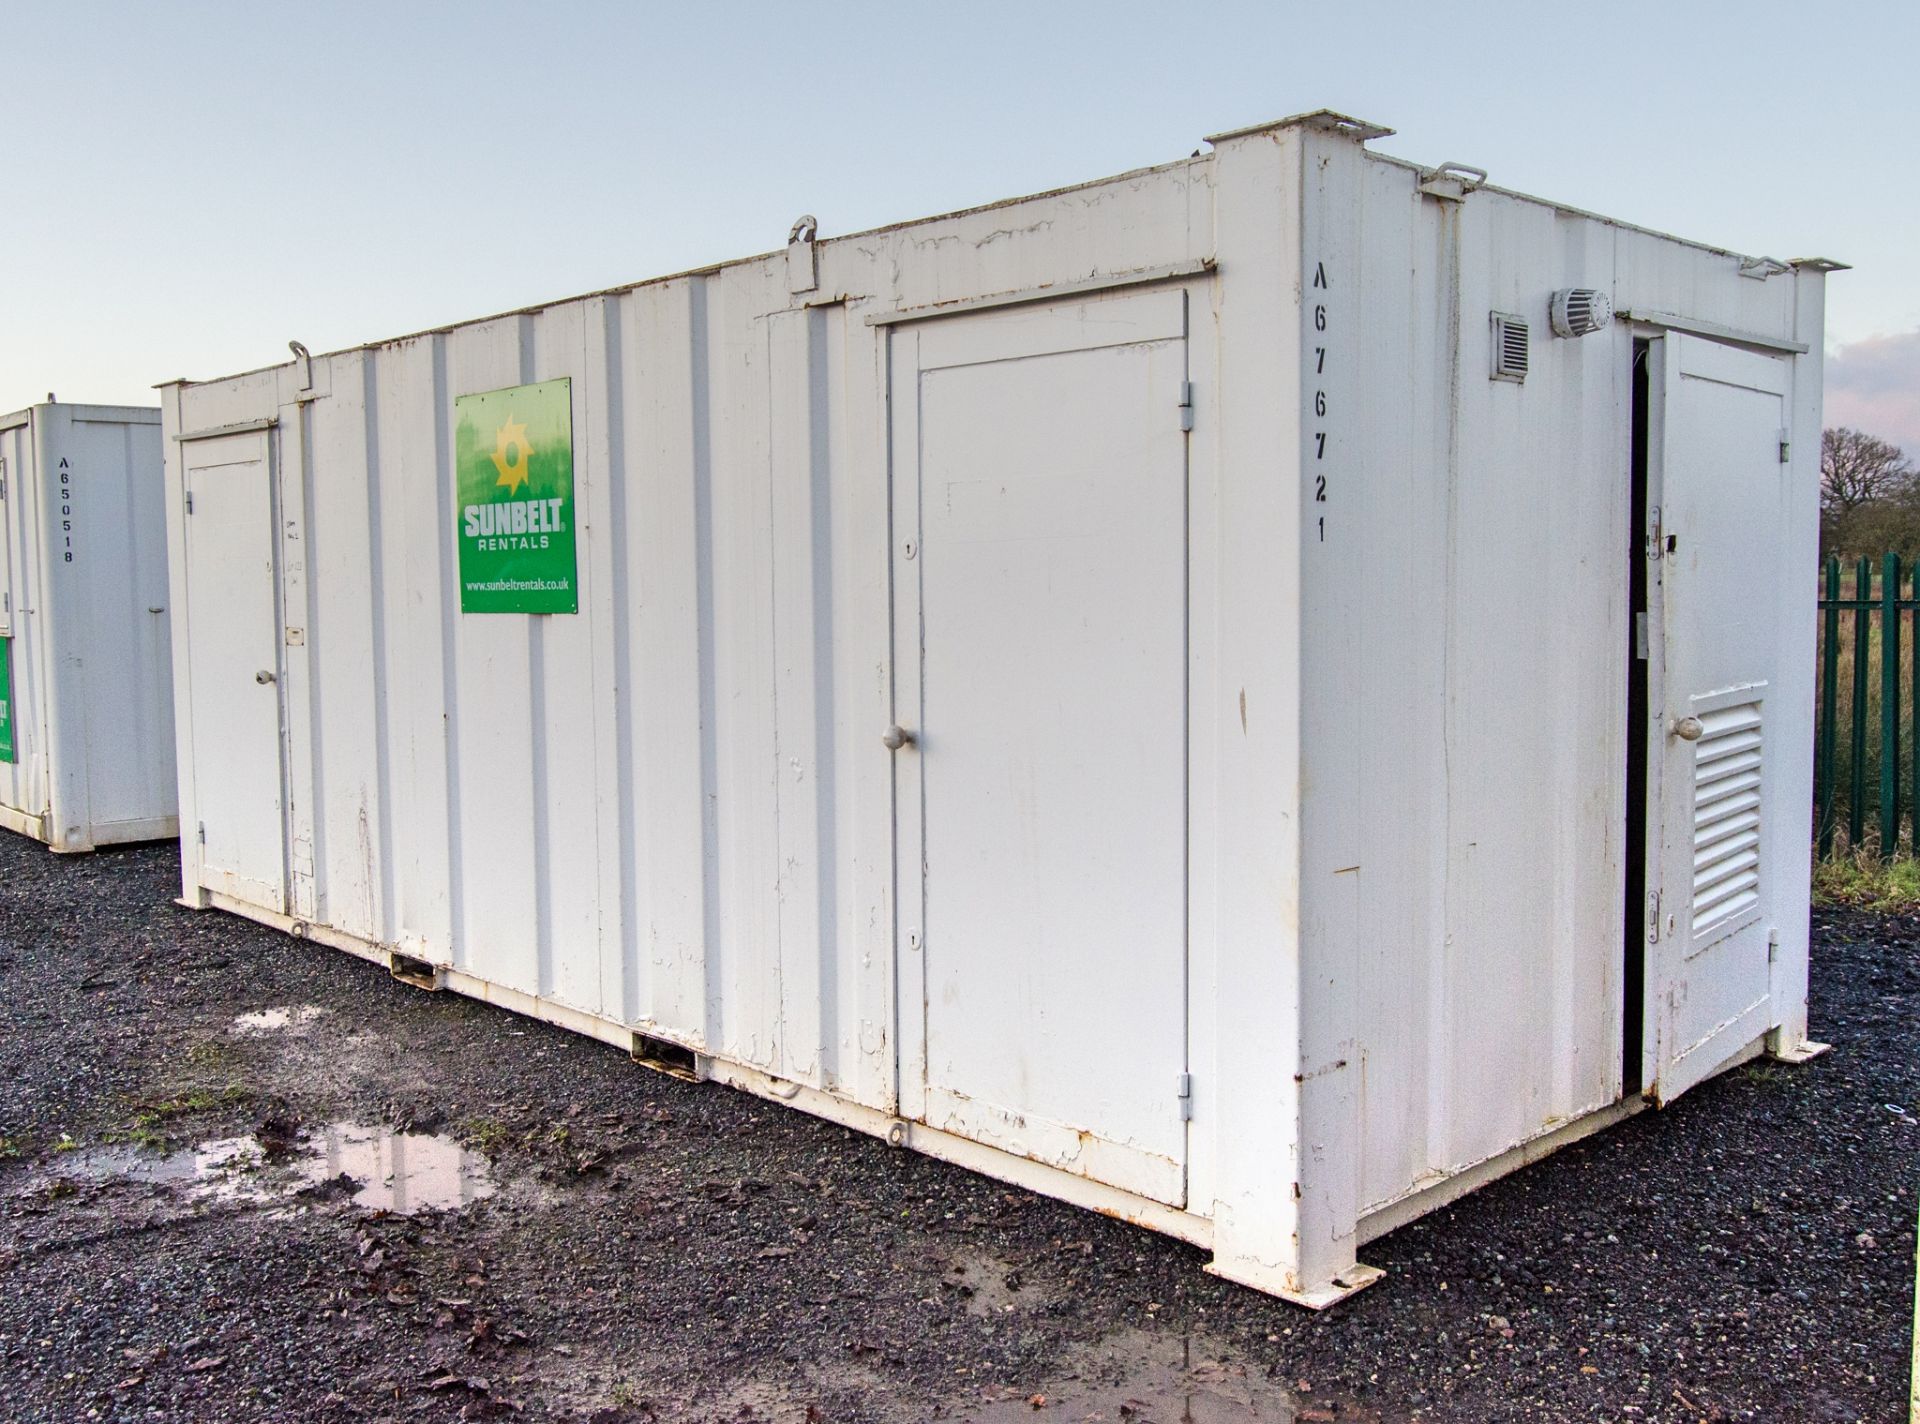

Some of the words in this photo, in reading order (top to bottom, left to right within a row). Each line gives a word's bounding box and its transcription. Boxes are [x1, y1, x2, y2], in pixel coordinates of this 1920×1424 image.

[1313, 261, 1328, 542] A676721
[59, 457, 73, 562] A650518
[464, 498, 564, 537] SUNBELT
[478, 535, 549, 551] RENTALS
[465, 577, 569, 591] www.sunbeltrentals.co.uk
